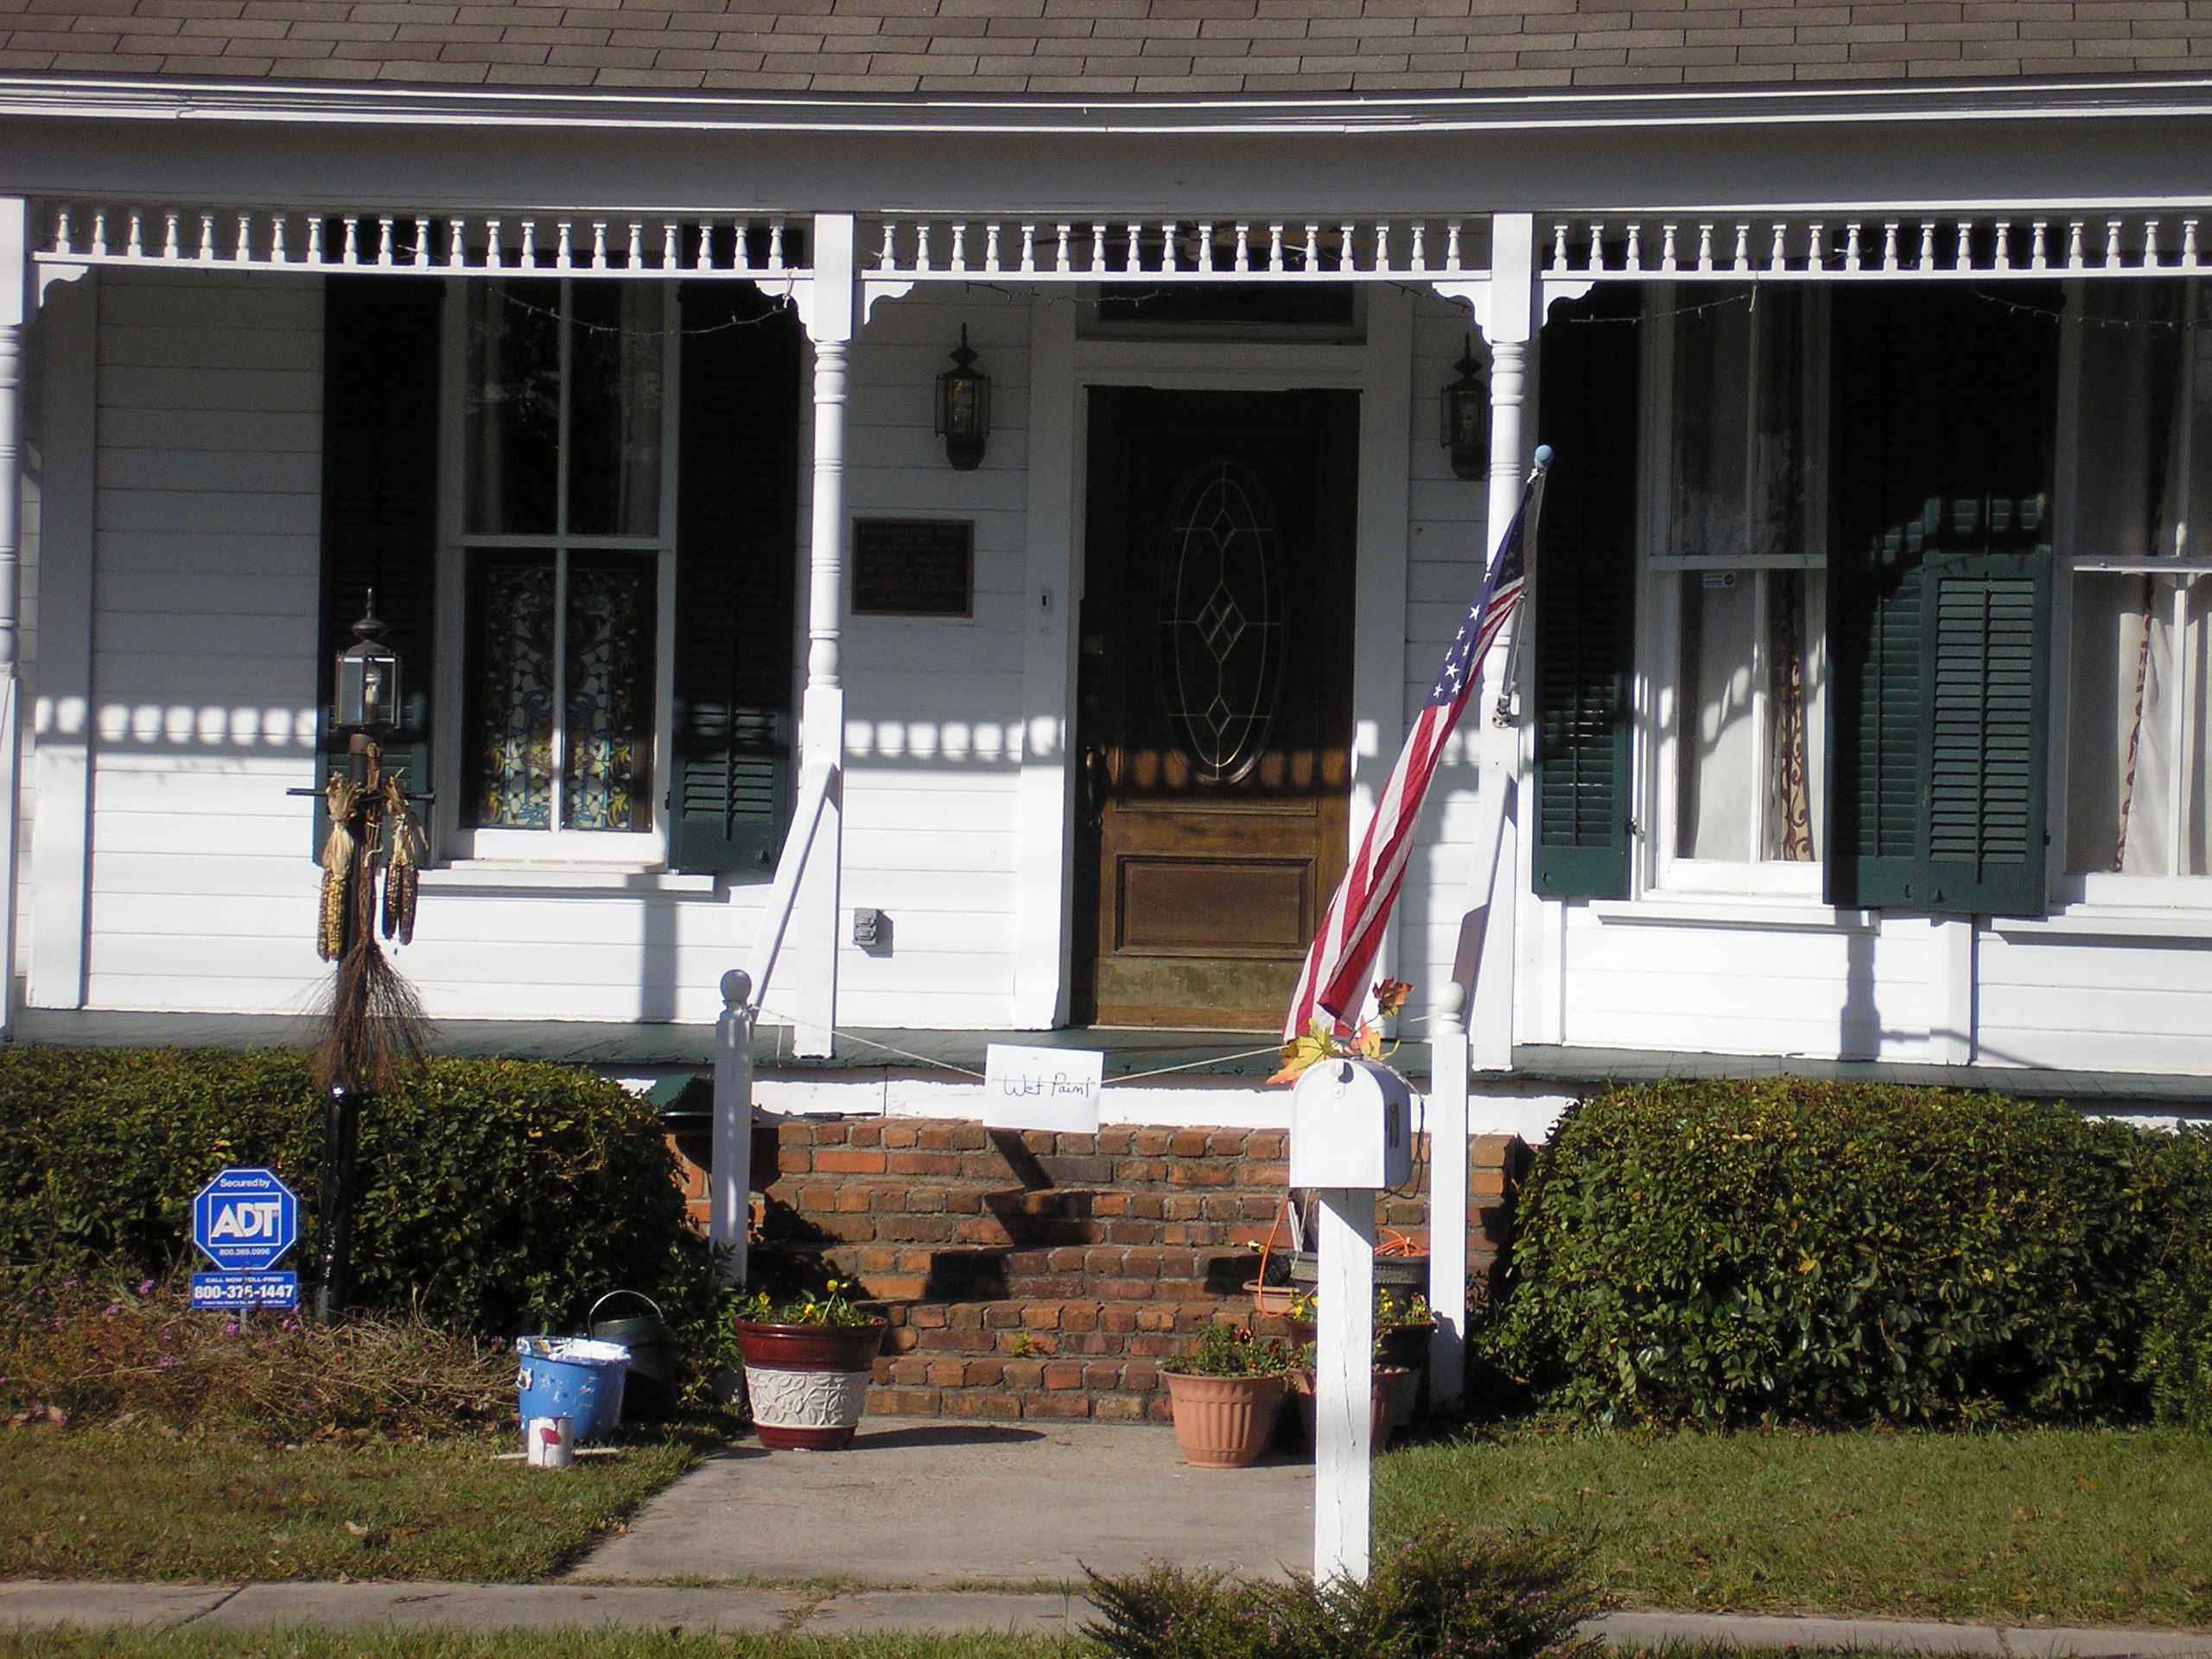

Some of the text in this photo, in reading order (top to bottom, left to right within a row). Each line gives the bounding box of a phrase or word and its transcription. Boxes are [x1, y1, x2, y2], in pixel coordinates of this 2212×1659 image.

[1003, 1071, 1090, 1099] Wet Paint
[220, 1178, 270, 1188] Secured by
[211, 1203, 279, 1237] ADT
